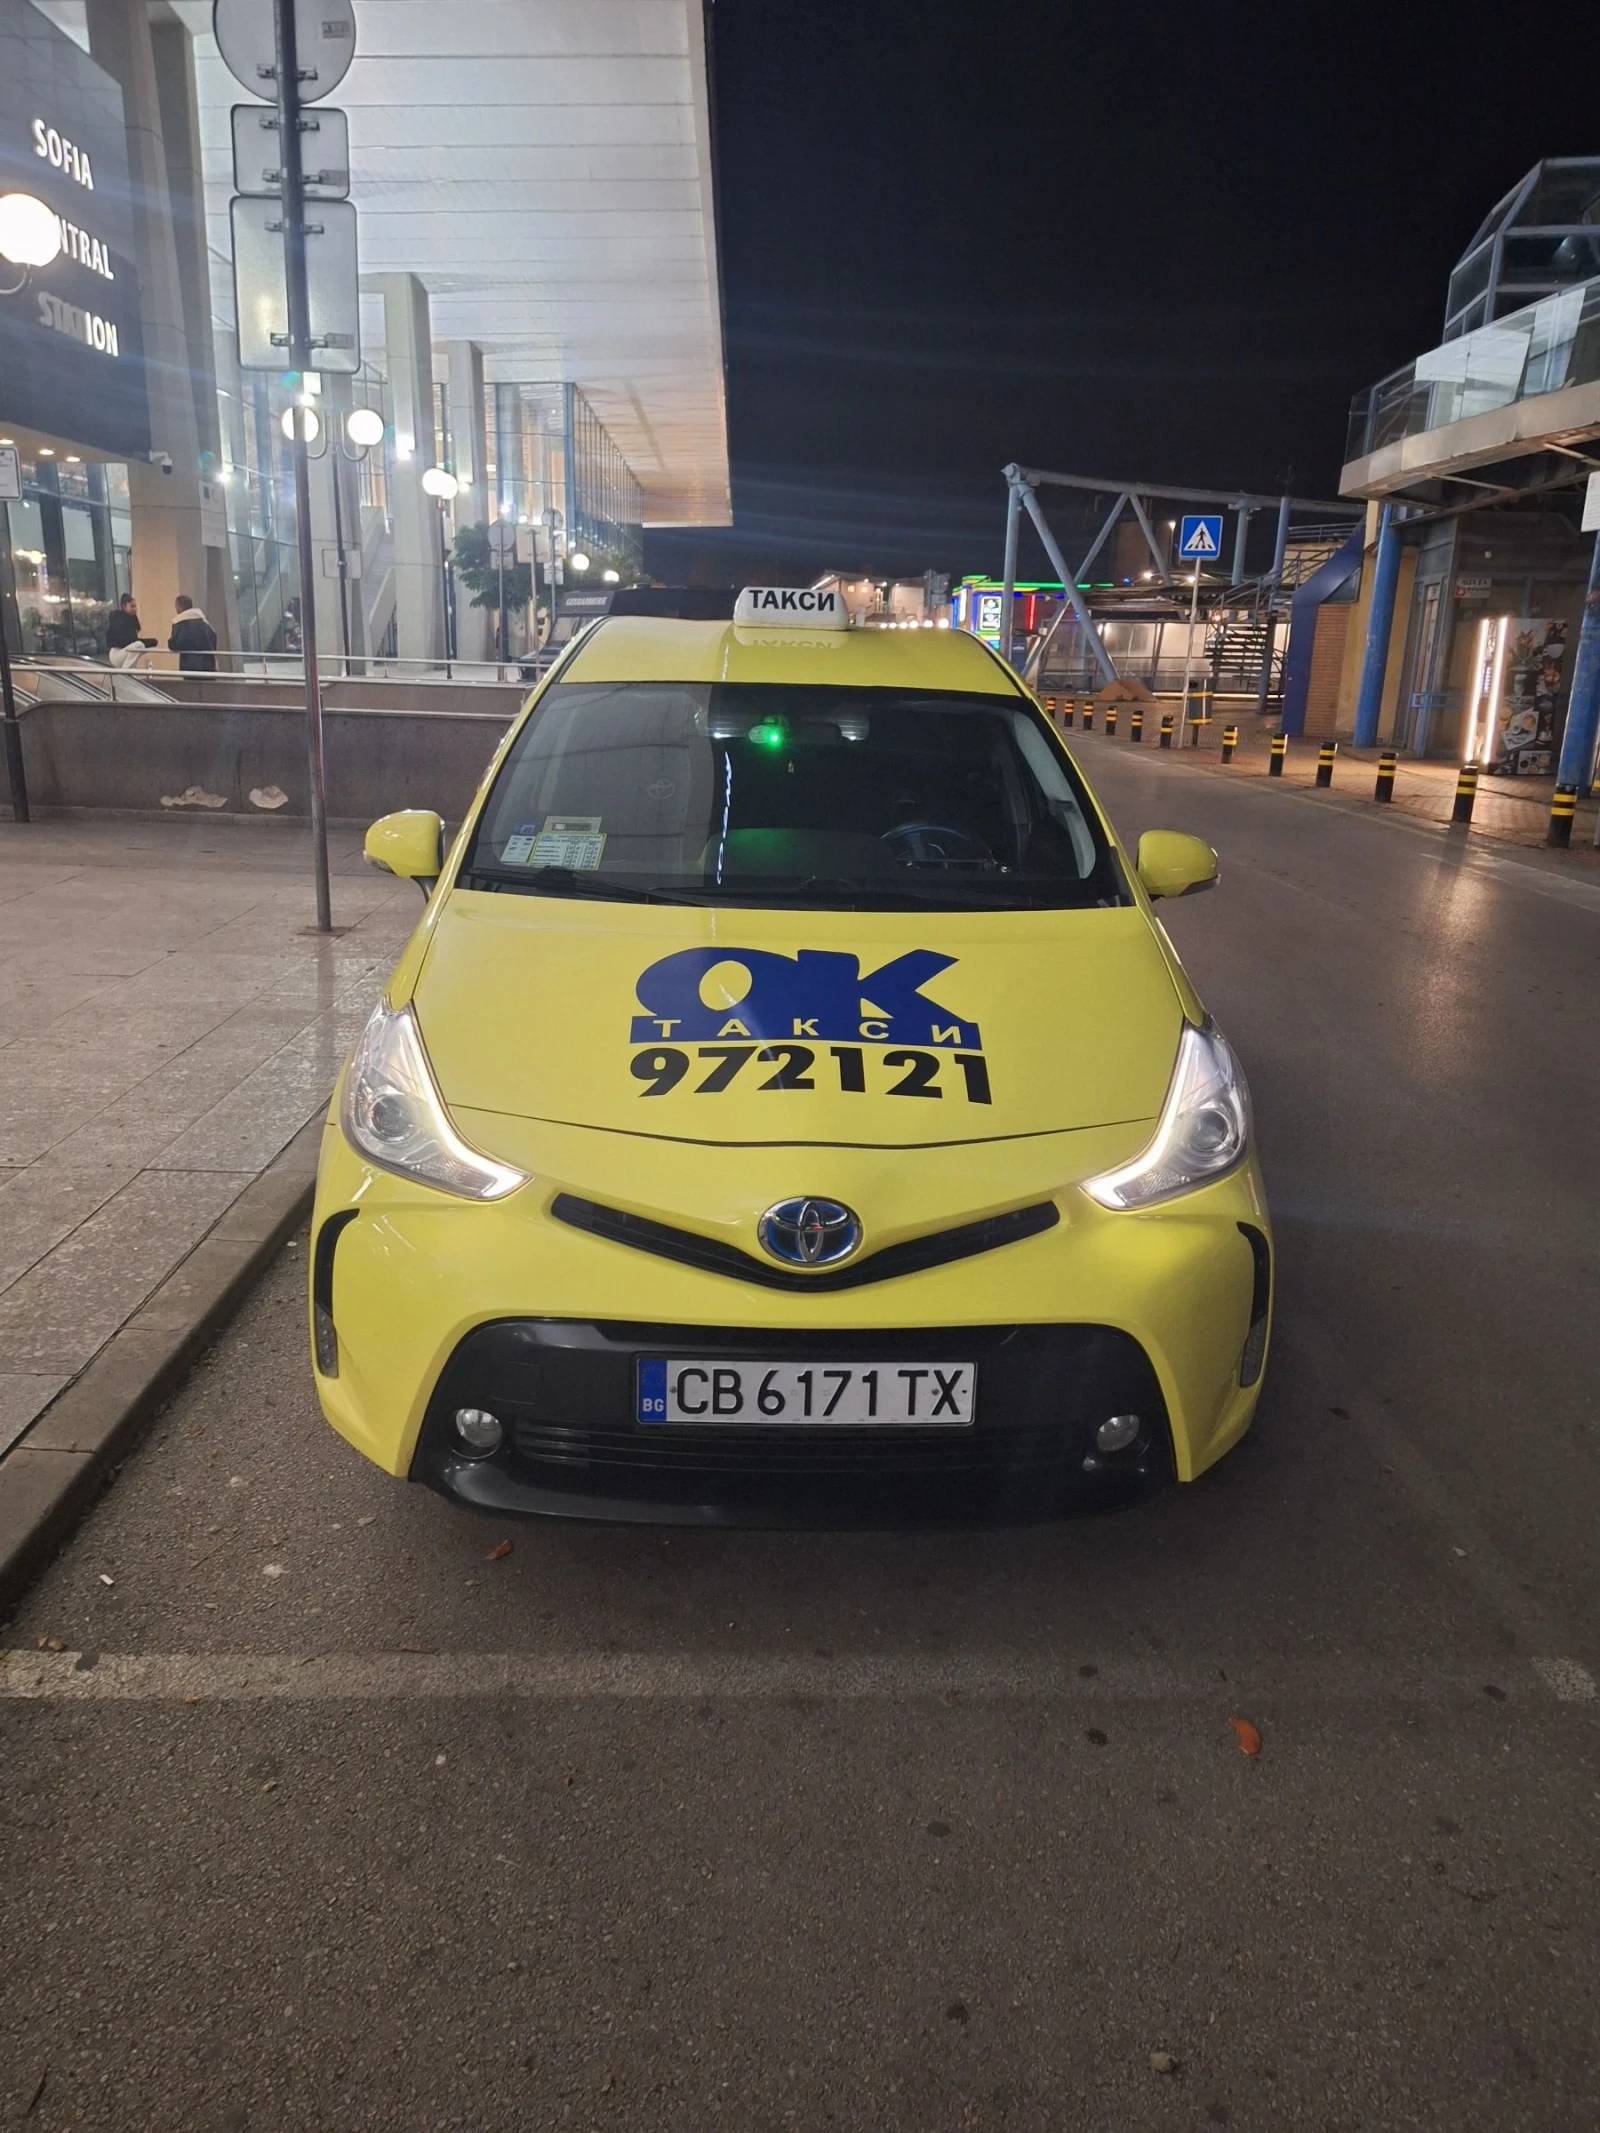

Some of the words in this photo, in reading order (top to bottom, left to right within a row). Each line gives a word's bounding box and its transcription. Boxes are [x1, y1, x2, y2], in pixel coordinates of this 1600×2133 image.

[33, 118, 94, 190] SOFIA
[54, 214, 115, 280] NTRAL
[38, 291, 119, 357] STATION
[748, 589, 835, 612] ТАКСИ
[653, 1017, 962, 1045] ТАКСИ
[630, 1045, 993, 1106] 972121
[642, 1398, 665, 1413] BG
[757, 1369, 879, 1416] 6171
